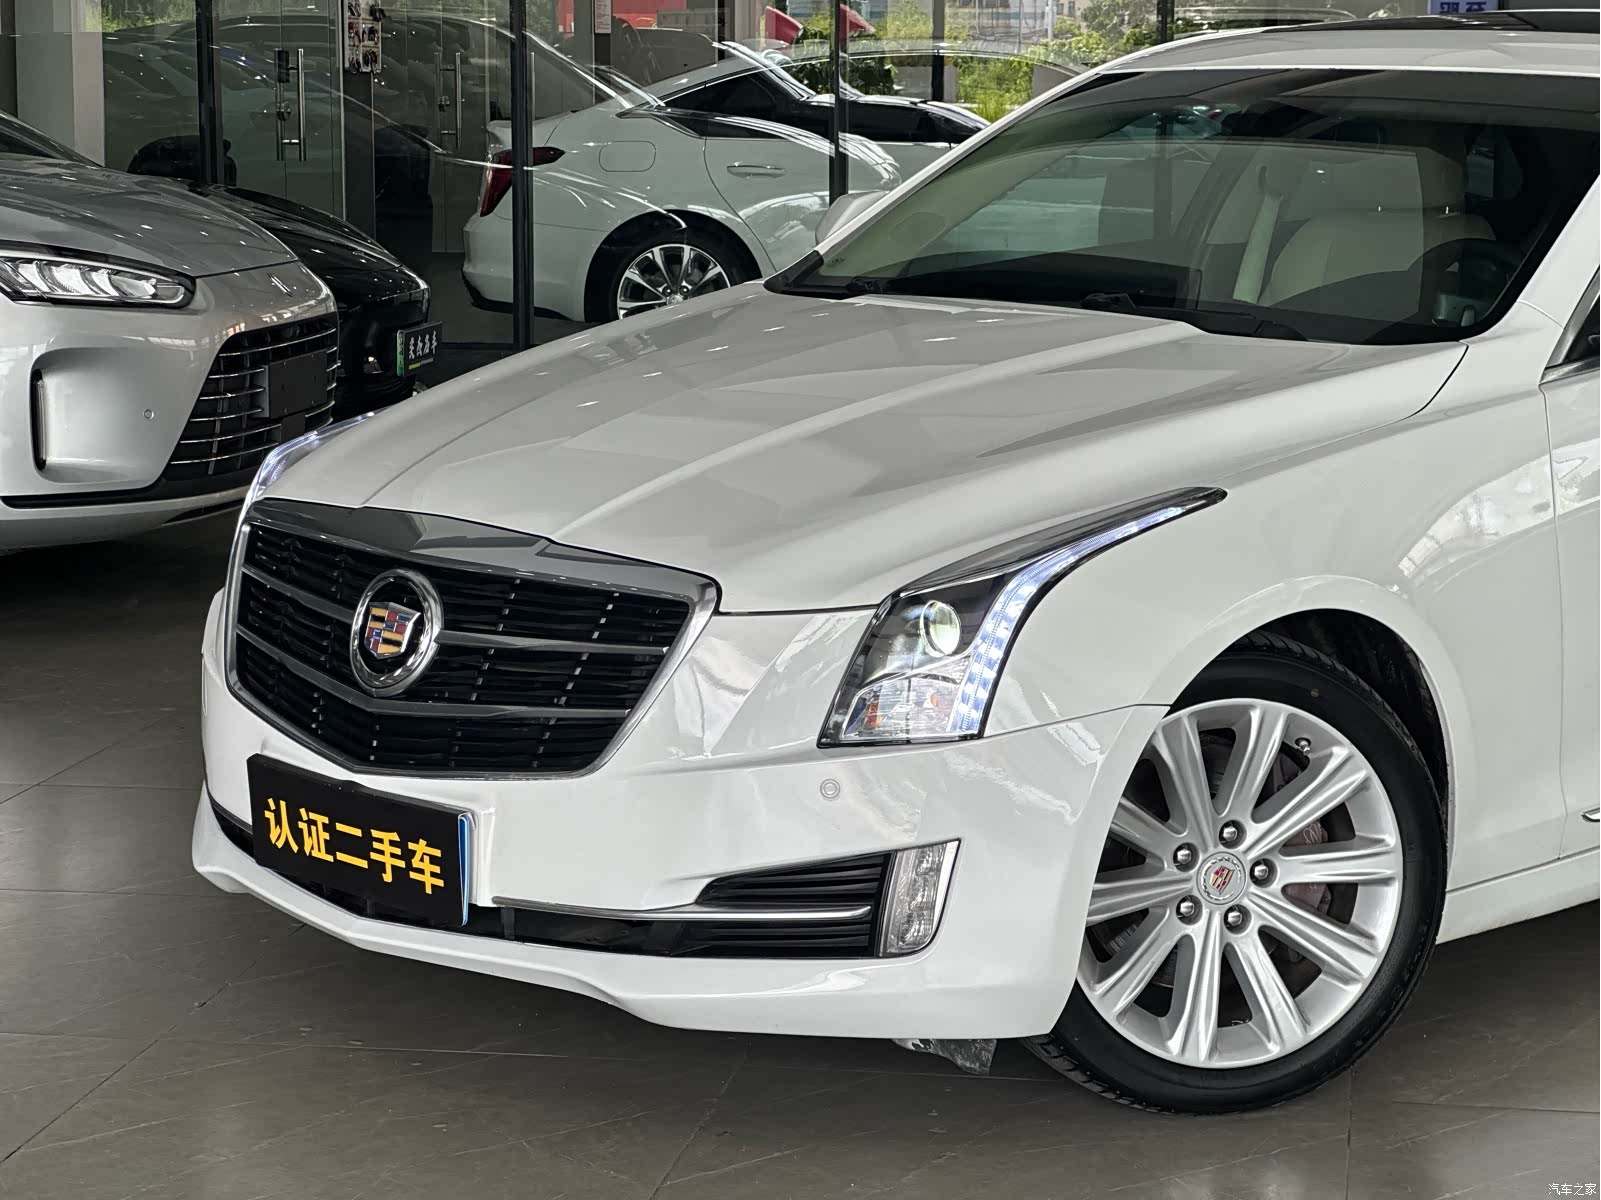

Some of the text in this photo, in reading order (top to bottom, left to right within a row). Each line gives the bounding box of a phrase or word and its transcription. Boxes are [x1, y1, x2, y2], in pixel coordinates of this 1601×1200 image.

[264, 798, 444, 895] 认证二手车
